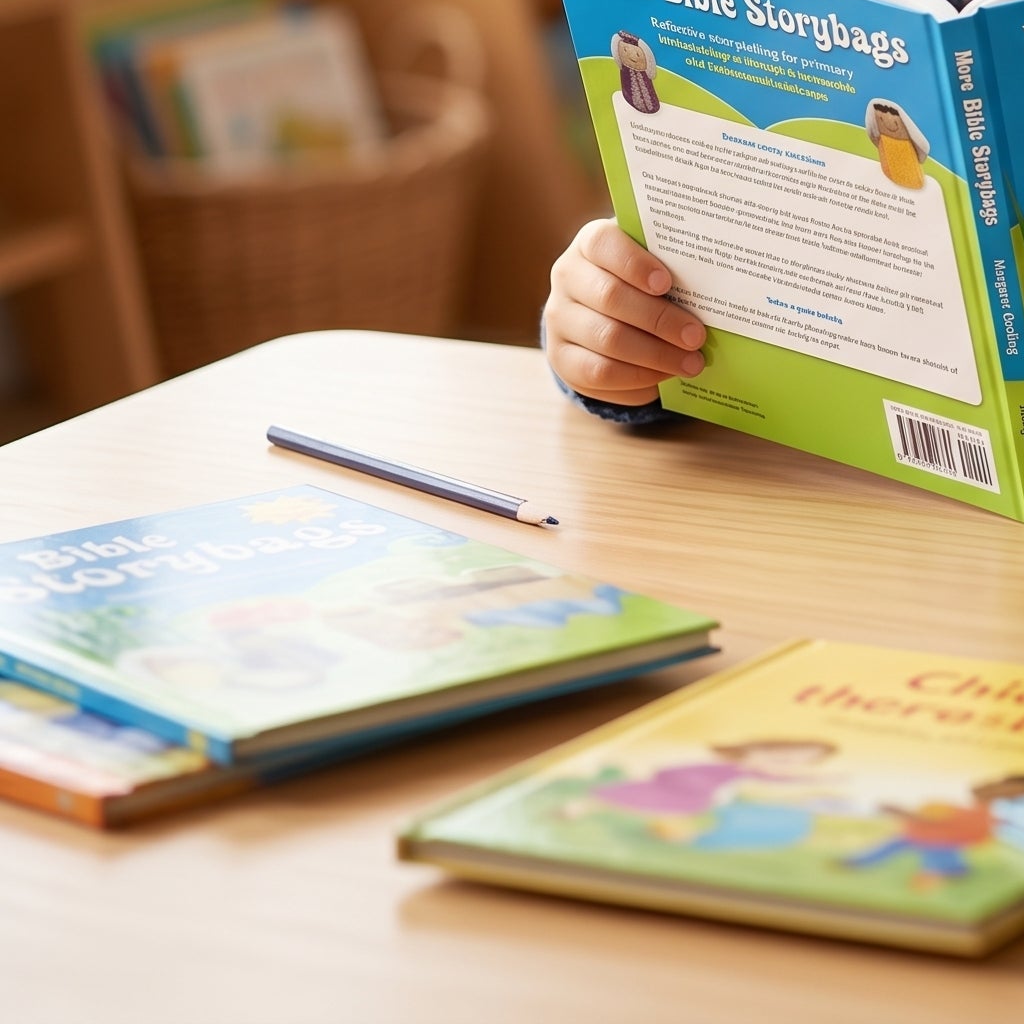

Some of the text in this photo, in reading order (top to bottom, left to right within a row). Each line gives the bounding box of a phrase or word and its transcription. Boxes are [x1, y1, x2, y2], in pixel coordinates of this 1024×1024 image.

[781, 50, 798, 64] for
[954, 50, 974, 91] More
[17, 533, 178, 570] Bible
